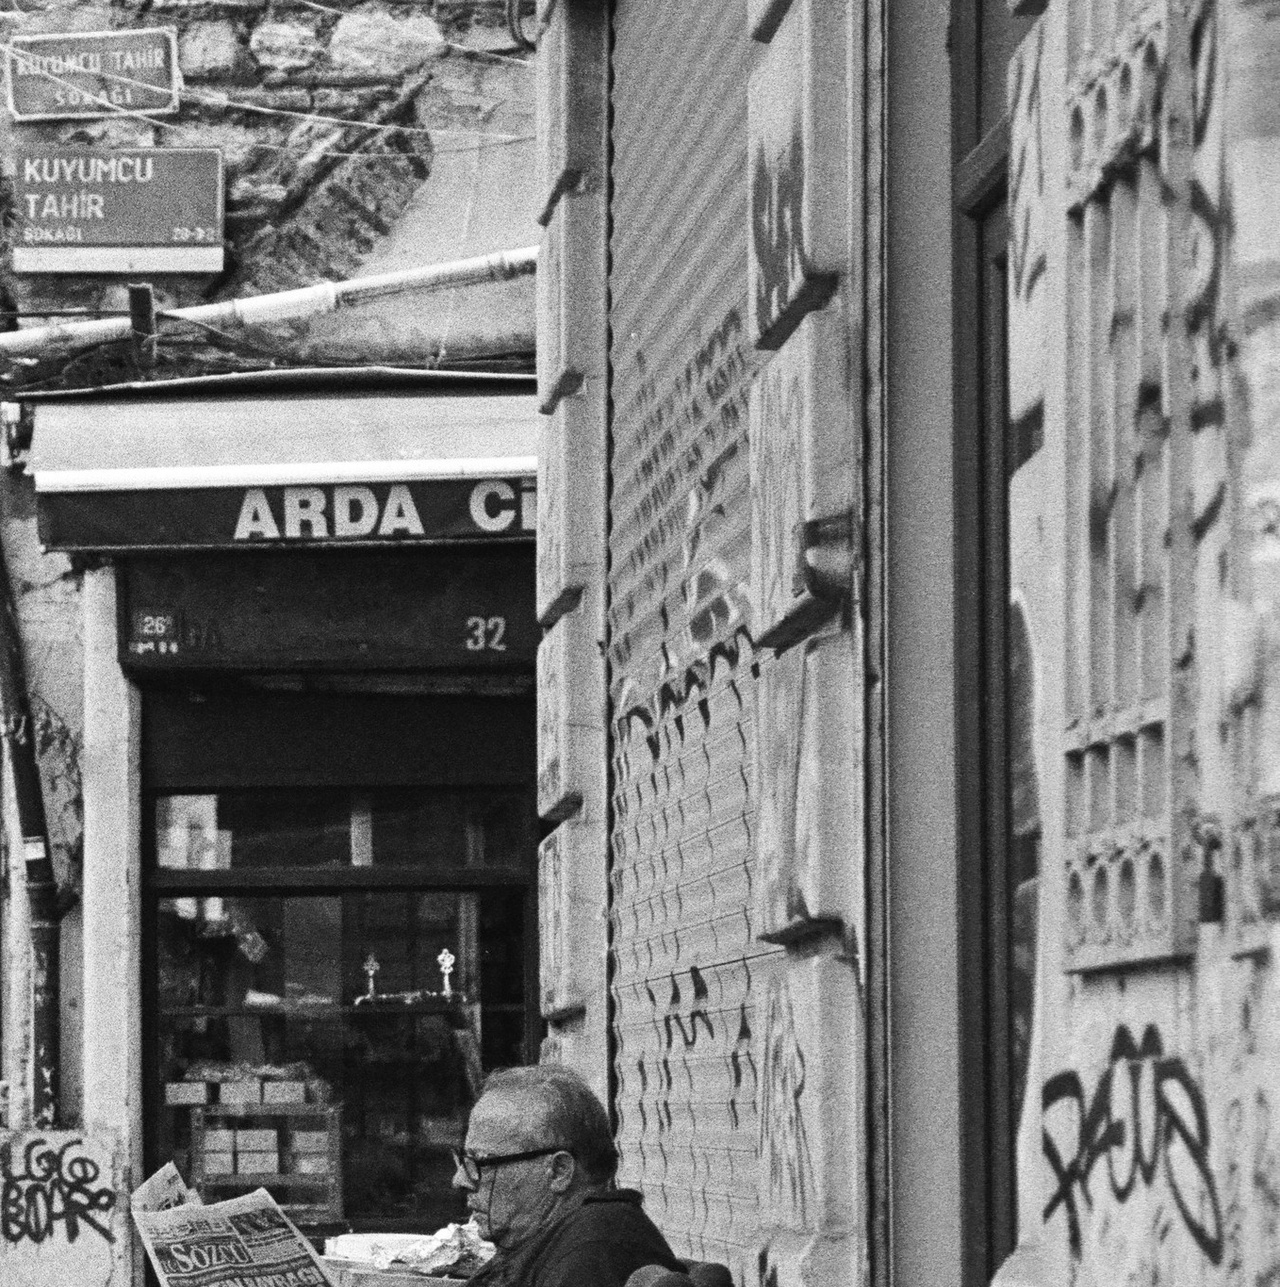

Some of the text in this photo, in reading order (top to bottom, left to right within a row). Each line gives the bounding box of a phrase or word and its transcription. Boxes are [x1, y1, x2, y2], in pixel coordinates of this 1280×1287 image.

[23, 156, 154, 184] KUYUMCU
[24, 188, 105, 220] TAHİR
[233, 483, 425, 541] ARDA
[466, 615, 508, 652] 32
